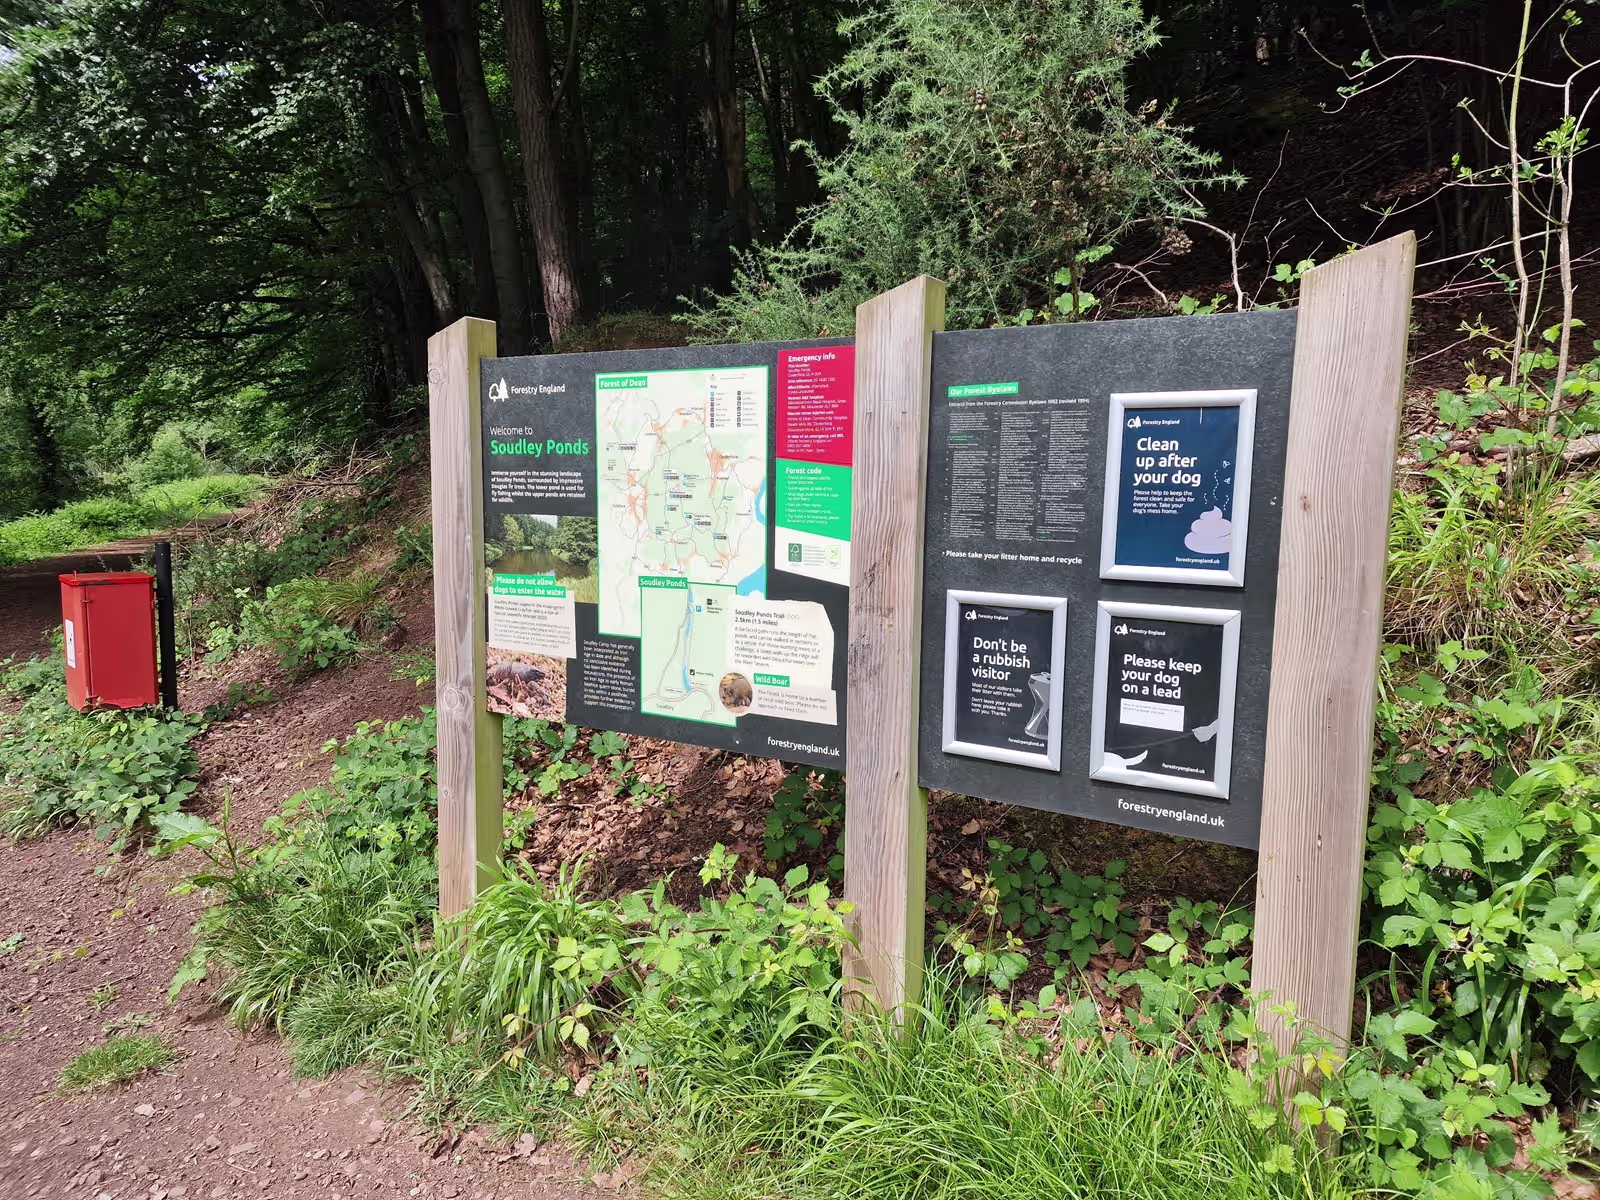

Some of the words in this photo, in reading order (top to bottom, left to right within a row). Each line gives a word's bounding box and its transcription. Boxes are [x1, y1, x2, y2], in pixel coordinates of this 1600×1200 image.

[511, 385, 537, 395] Forestry
[539, 384, 565, 394] England
[988, 386, 1016, 394] Byelaws
[490, 426, 522, 435] Welcome
[525, 426, 533, 435] to
[490, 439, 543, 458] Soudley
[546, 438, 589, 455] Ponds
[1137, 437, 1179, 451] Clean
[1136, 456, 1154, 470] up
[1159, 453, 1197, 467] after
[1133, 473, 1168, 486] your
[1172, 470, 1201, 487] dog
[1057, 557, 1082, 565] recycle
[640, 579, 665, 587] Soudley
[974, 637, 1007, 651] Don't
[1011, 640, 1026, 653] be
[973, 653, 979, 662] a
[983, 653, 1030, 668] rubbish
[1124, 654, 1165, 669] Please
[1169, 658, 1202, 675] keep
[972, 666, 1010, 680] visitor
[1121, 670, 1151, 681] your
[1154, 671, 1179, 686] dog
[1122, 684, 1138, 693] on
[1142, 686, 1149, 695] a
[1153, 684, 1181, 699] lead
[768, 737, 840, 756] forestryengland.uk
[1008, 738, 1044, 747] forestryengland.uk
[1162, 763, 1205, 774] forestryengland.uk
[1118, 798, 1224, 827] forestryengland.uk
